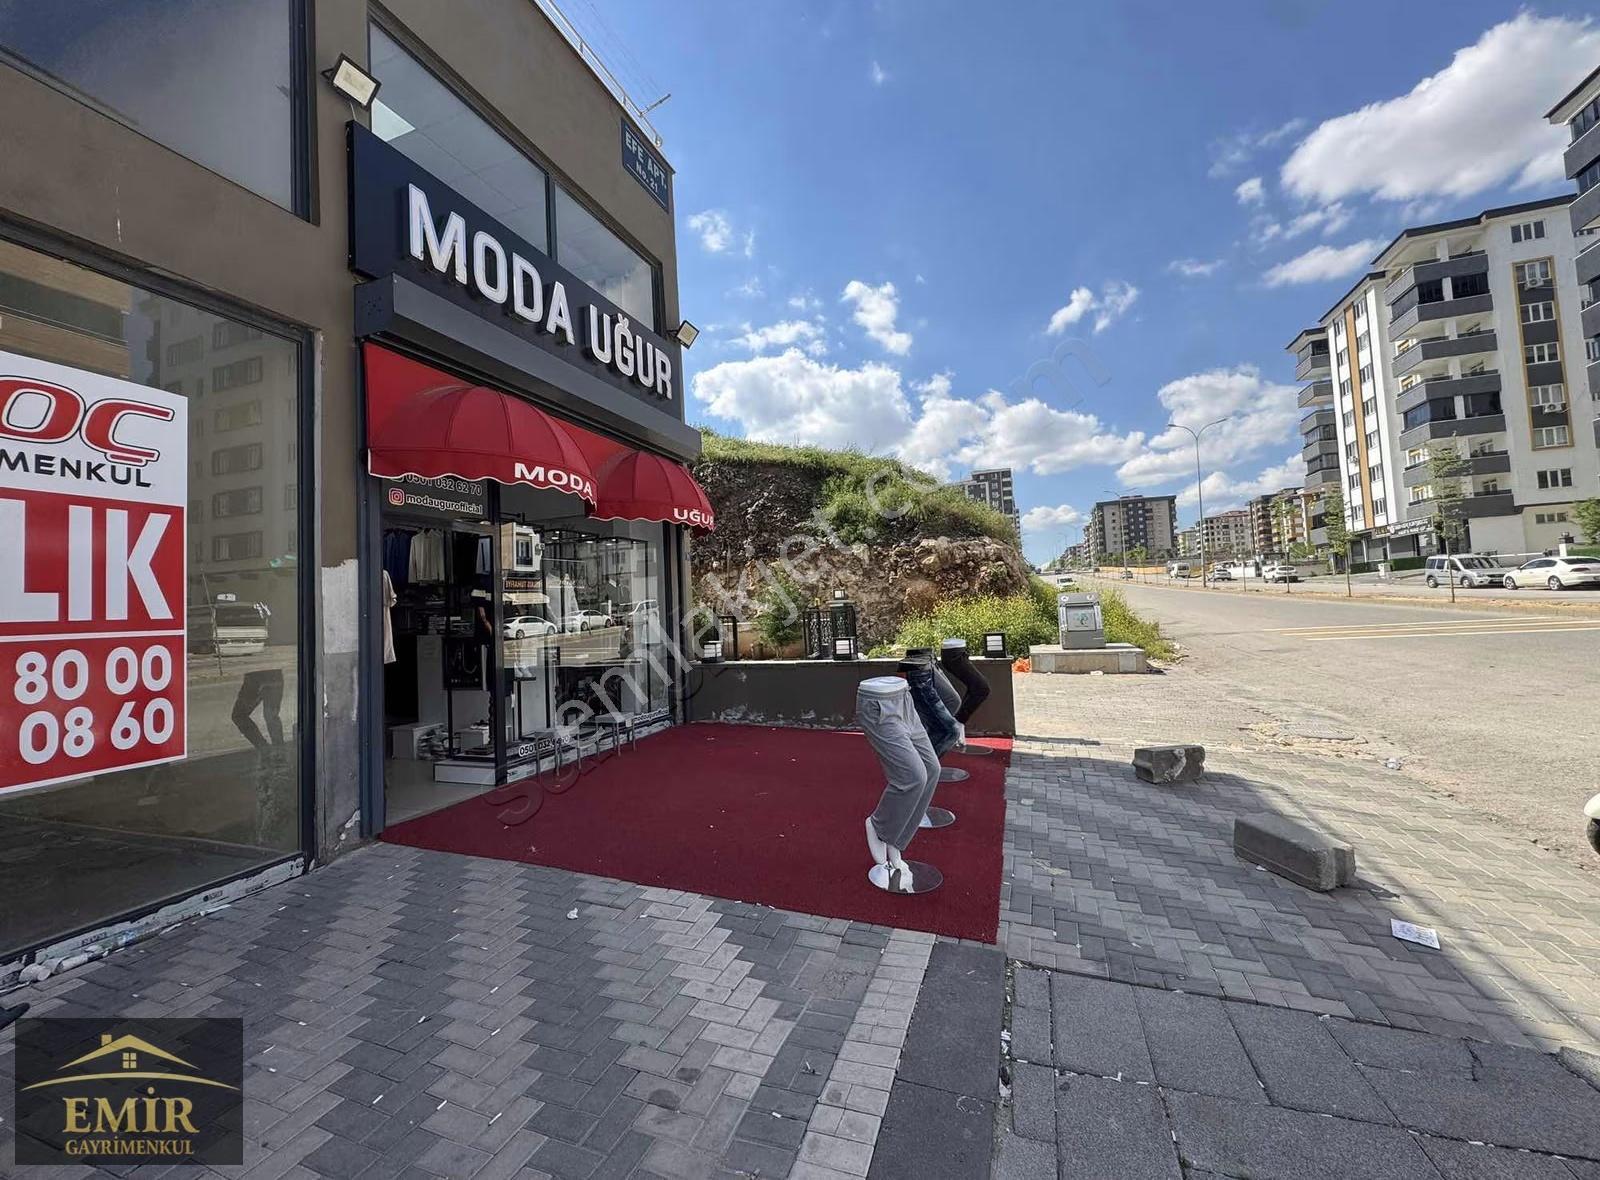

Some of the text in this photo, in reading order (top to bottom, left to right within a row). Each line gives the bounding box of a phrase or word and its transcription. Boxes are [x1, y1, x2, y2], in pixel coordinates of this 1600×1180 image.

[625, 130, 667, 190] EFE APT.
[408, 183, 673, 400] MODA UĞUR
[456, 481, 469, 494] 62
[470, 483, 482, 496] 70
[514, 462, 593, 497] MODA
[14, 645, 172, 705] 80 00
[19, 697, 175, 765] 08 60
